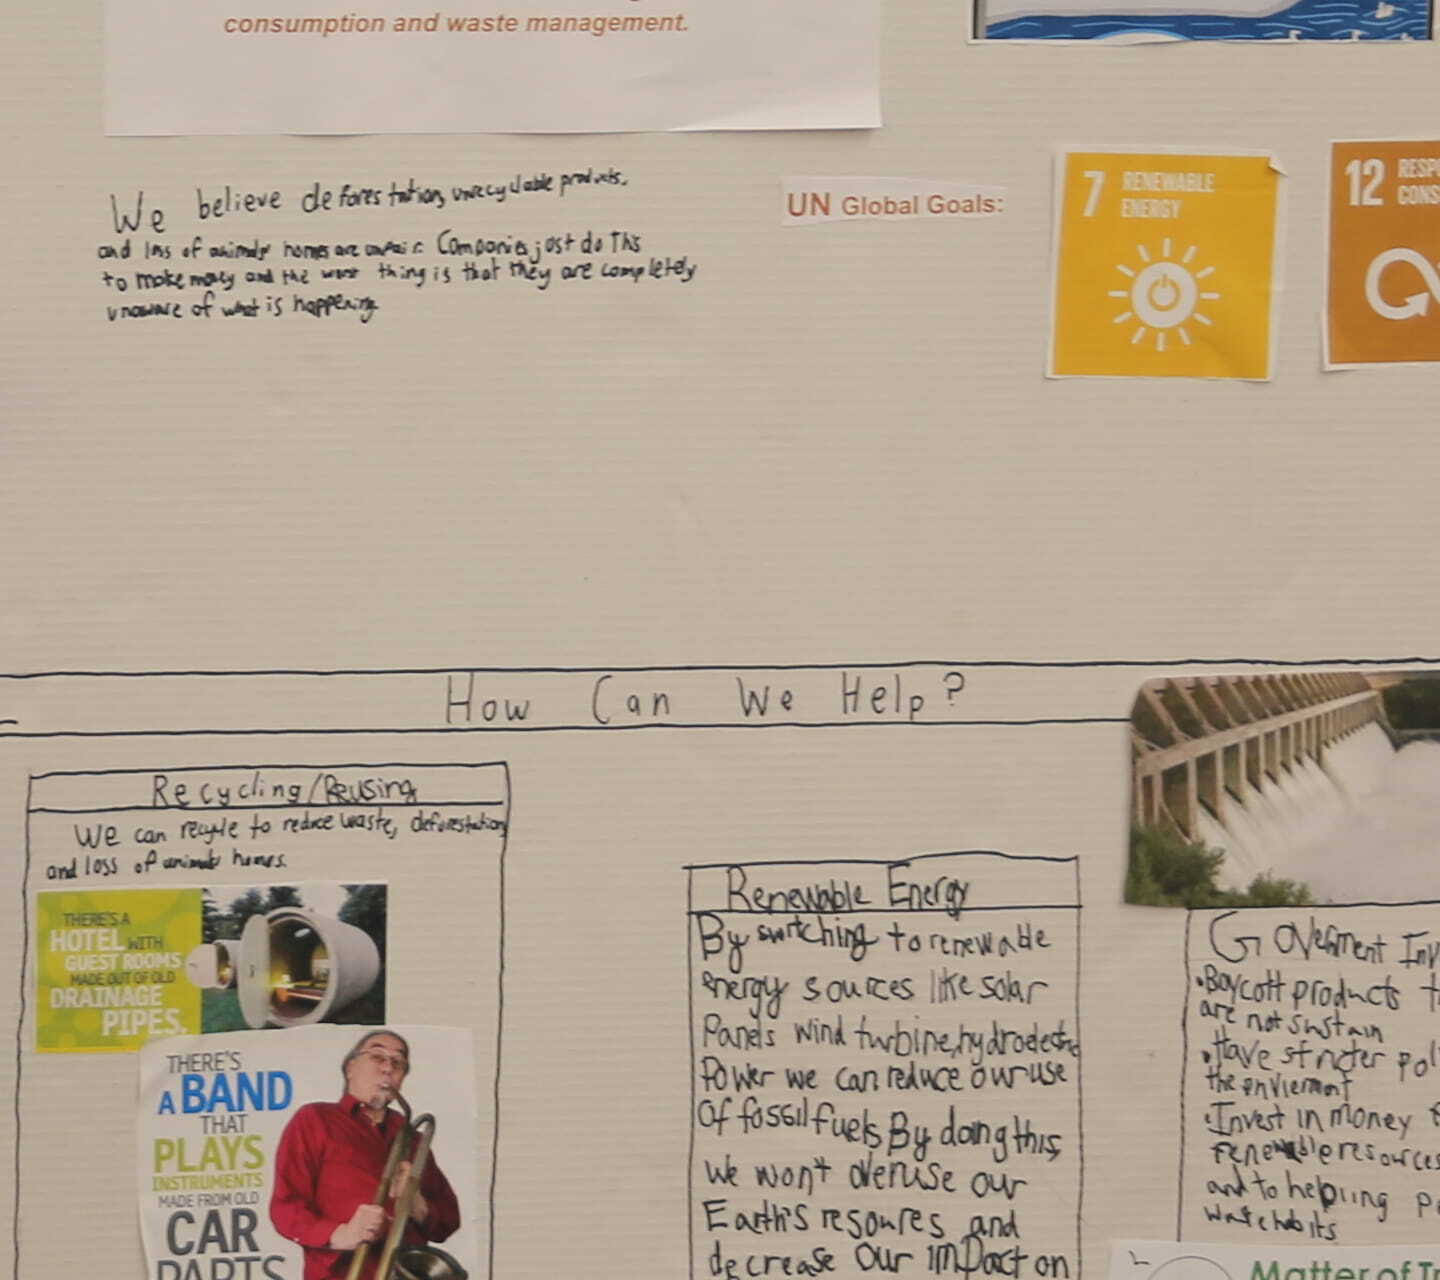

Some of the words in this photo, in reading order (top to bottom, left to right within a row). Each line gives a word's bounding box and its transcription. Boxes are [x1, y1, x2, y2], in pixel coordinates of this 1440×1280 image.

[1081, 170, 1105, 217] 7
[1122, 172, 1215, 193] RENEWABLE
[1345, 158, 1386, 206] 12
[111, 191, 166, 234] We
[197, 187, 281, 221] believe
[788, 192, 831, 217] UN
[841, 195, 919, 216] Global
[927, 194, 1003, 215] Goals:
[1121, 199, 1182, 219] ENERGY
[445, 672, 530, 723] How
[591, 675, 670, 724] Can
[735, 676, 794, 717] We
[841, 671, 965, 722] Help?
[74, 825, 118, 849] We
[135, 825, 167, 843] can
[250, 812, 271, 839] to
[727, 865, 872, 913] Renewable
[887, 861, 969, 919] Energy
[64, 912, 117, 927] THERE'S
[120, 912, 131, 925] A
[50, 928, 125, 952] HOTEL
[128, 936, 163, 950] WITH
[64, 954, 119, 971] GUEST
[123, 952, 182, 969] ROOMS
[71, 973, 104, 986] MADE
[108, 973, 131, 985] OUT
[134, 972, 150, 984] OF
[152, 971, 175, 983] OLD
[50, 985, 163, 1009] DRAINAGE
[102, 1008, 188, 1037] PIPES.
[166, 1051, 240, 1073] THERE'S
[158, 1091, 176, 1114] A
[182, 1070, 293, 1114] BAND
[200, 1114, 248, 1134] THAT
[153, 1134, 264, 1173] PLAYS
[152, 1173, 264, 1191] INSTRUMENTS
[158, 1194, 194, 1208] MADE
[198, 1194, 234, 1206] FROM
[234, 1192, 259, 1205] OLD
[166, 1208, 260, 1256] CAR
